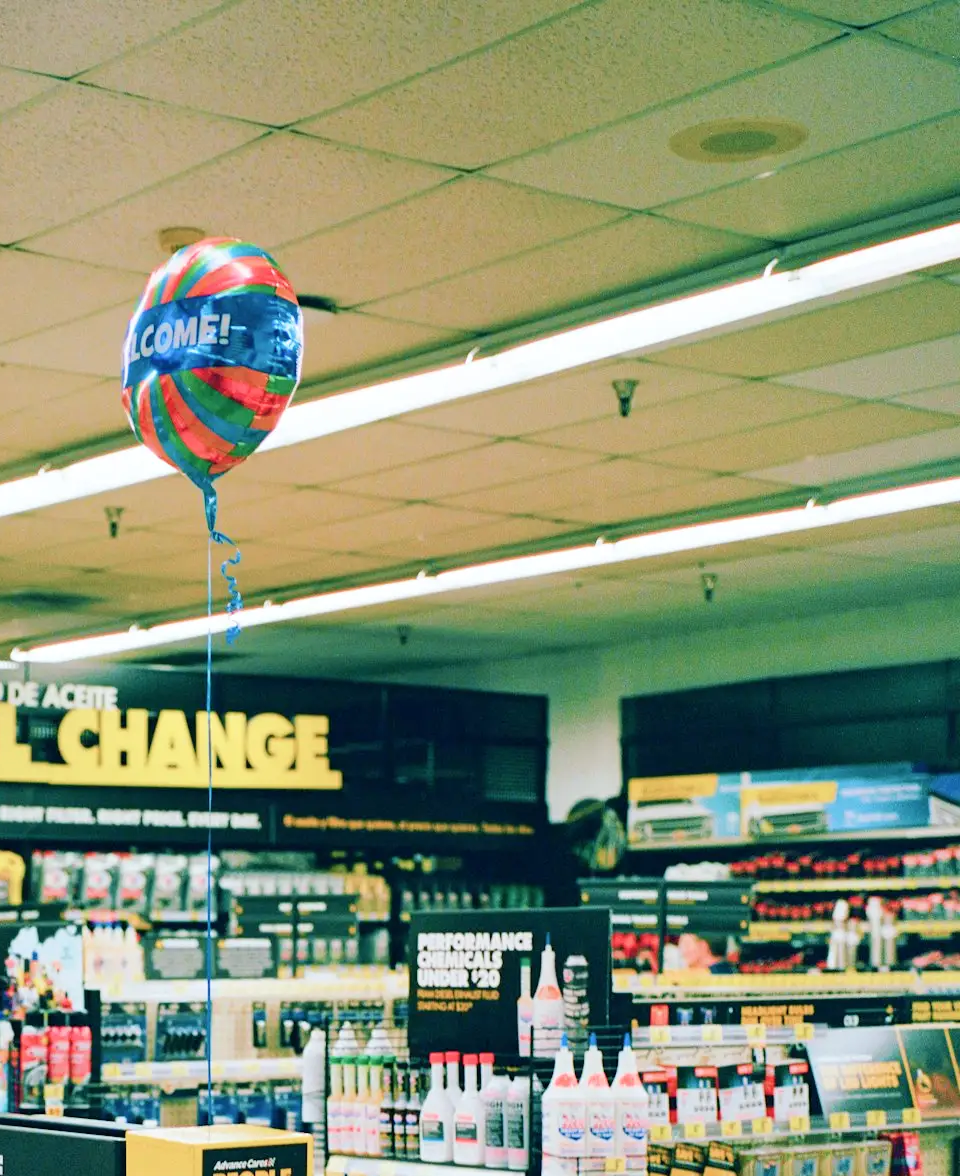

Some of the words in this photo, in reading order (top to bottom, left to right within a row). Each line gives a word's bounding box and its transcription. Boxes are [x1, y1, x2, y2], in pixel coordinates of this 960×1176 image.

[8, 682, 39, 707] DE
[42, 683, 118, 711] ACEITE
[57, 707, 331, 774] CHANGE
[417, 931, 533, 951] PERFORMANCE
[417, 951, 503, 969] CHEMICALS
[417, 969, 469, 988] UNDER
[471, 970, 501, 988] $20
[213, 1160, 247, 1171] Advance
